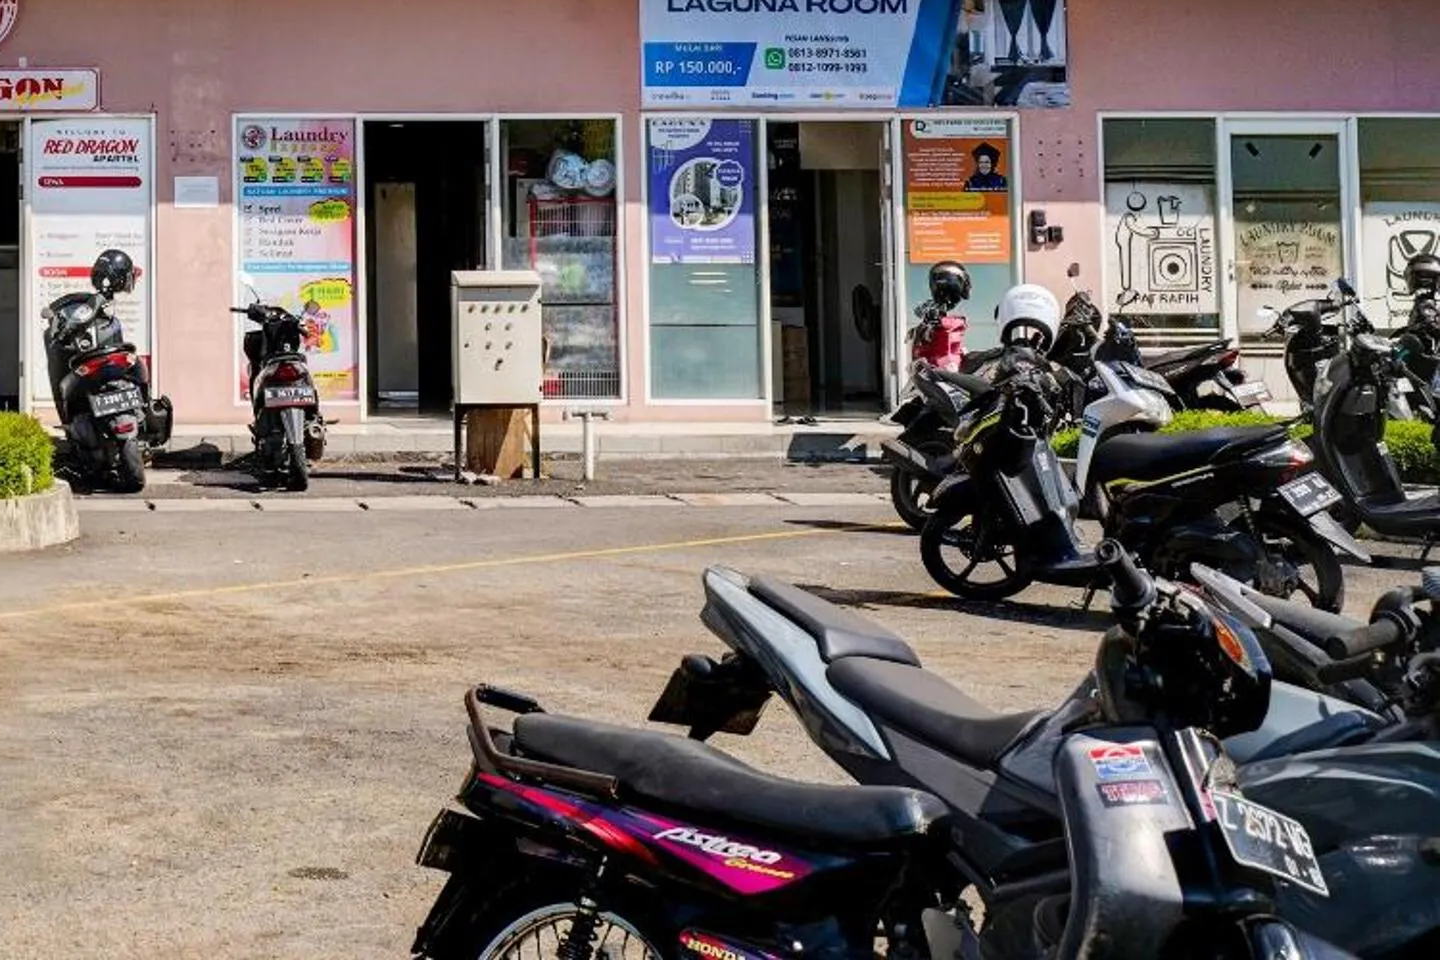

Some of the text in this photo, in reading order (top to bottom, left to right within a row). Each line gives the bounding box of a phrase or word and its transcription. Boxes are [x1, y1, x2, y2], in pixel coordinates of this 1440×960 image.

[655, 62, 673, 74] RP
[271, 126, 349, 144] Laundry
[44, 139, 140, 154] RED DRAGON
